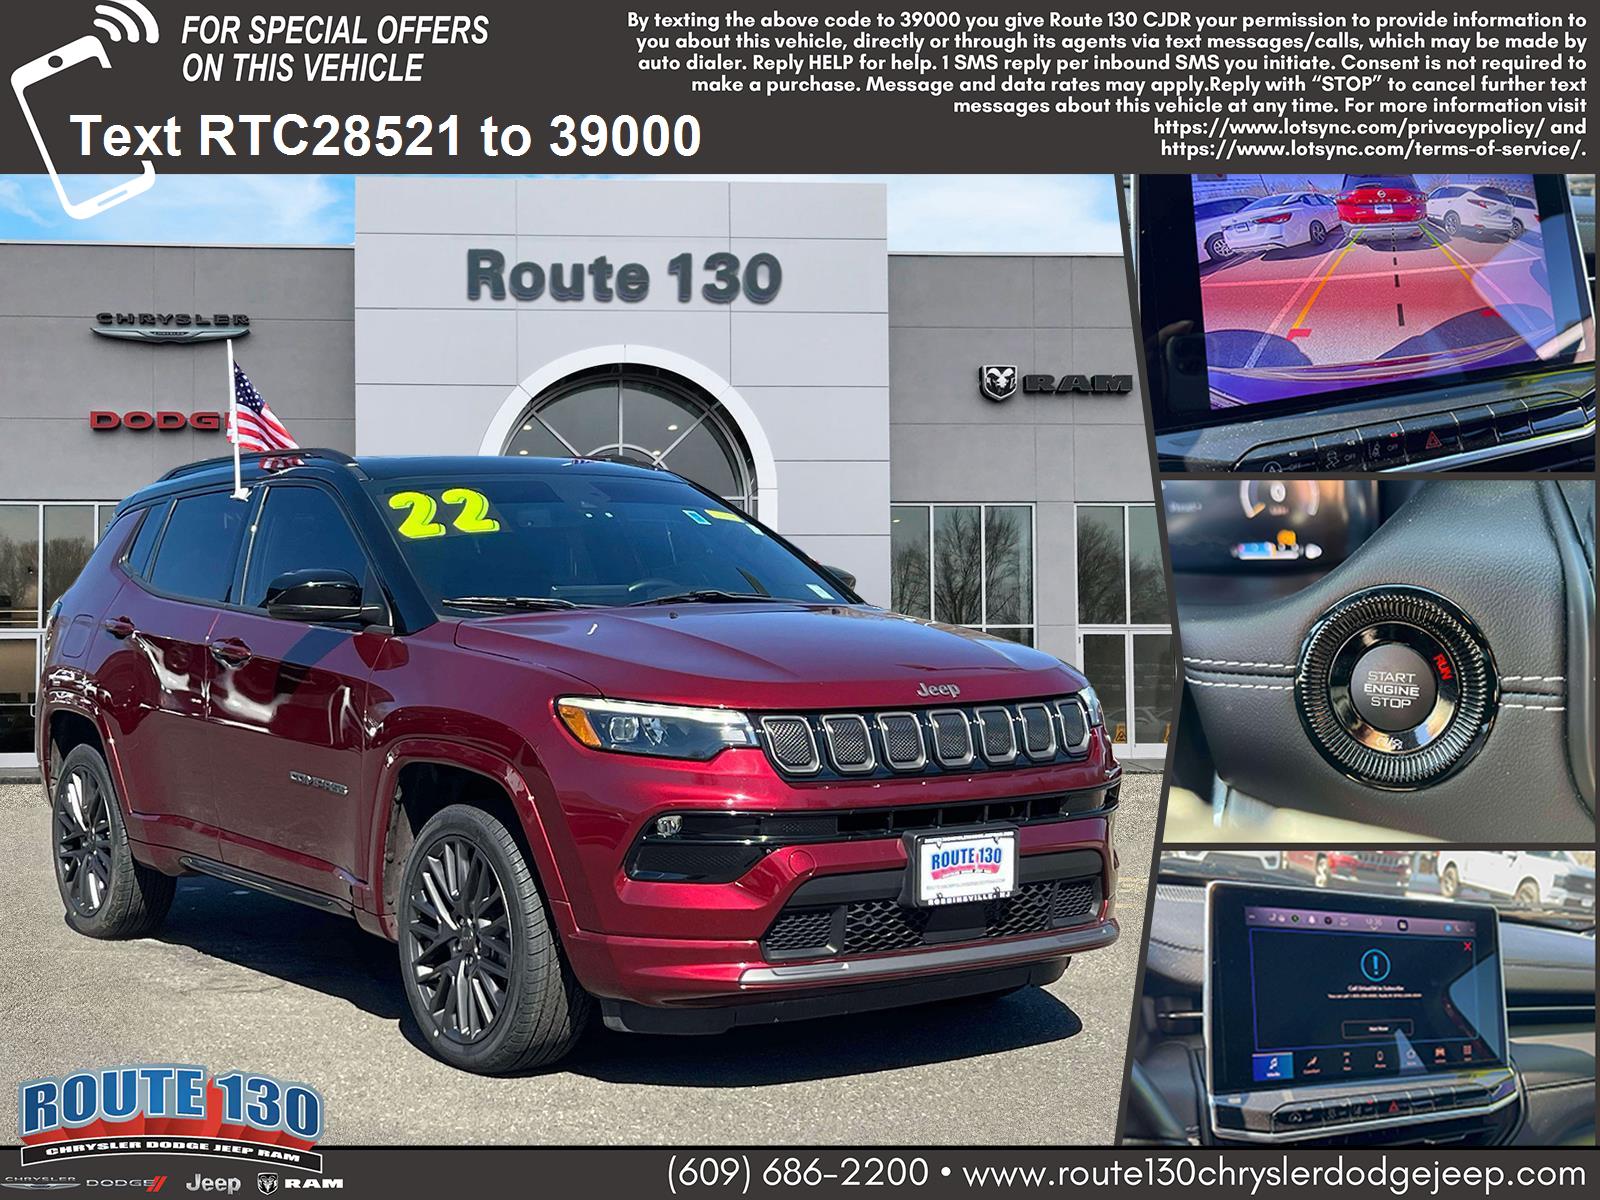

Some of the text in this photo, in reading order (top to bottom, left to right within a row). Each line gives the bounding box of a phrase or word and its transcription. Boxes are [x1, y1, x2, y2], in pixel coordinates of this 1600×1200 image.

[467, 249, 782, 304] Route 130
[96, 312, 250, 326] CHRYSLER
[1023, 374, 1133, 394] RAM
[91, 411, 232, 430] DODG
[389, 488, 500, 539] 22
[1433, 653, 1454, 680] RUN
[1367, 671, 1416, 683] START
[916, 682, 961, 699] Jeep
[1364, 683, 1420, 697] ENGINE
[1370, 696, 1412, 709] STOP
[931, 847, 1002, 870] ROUTE 130
